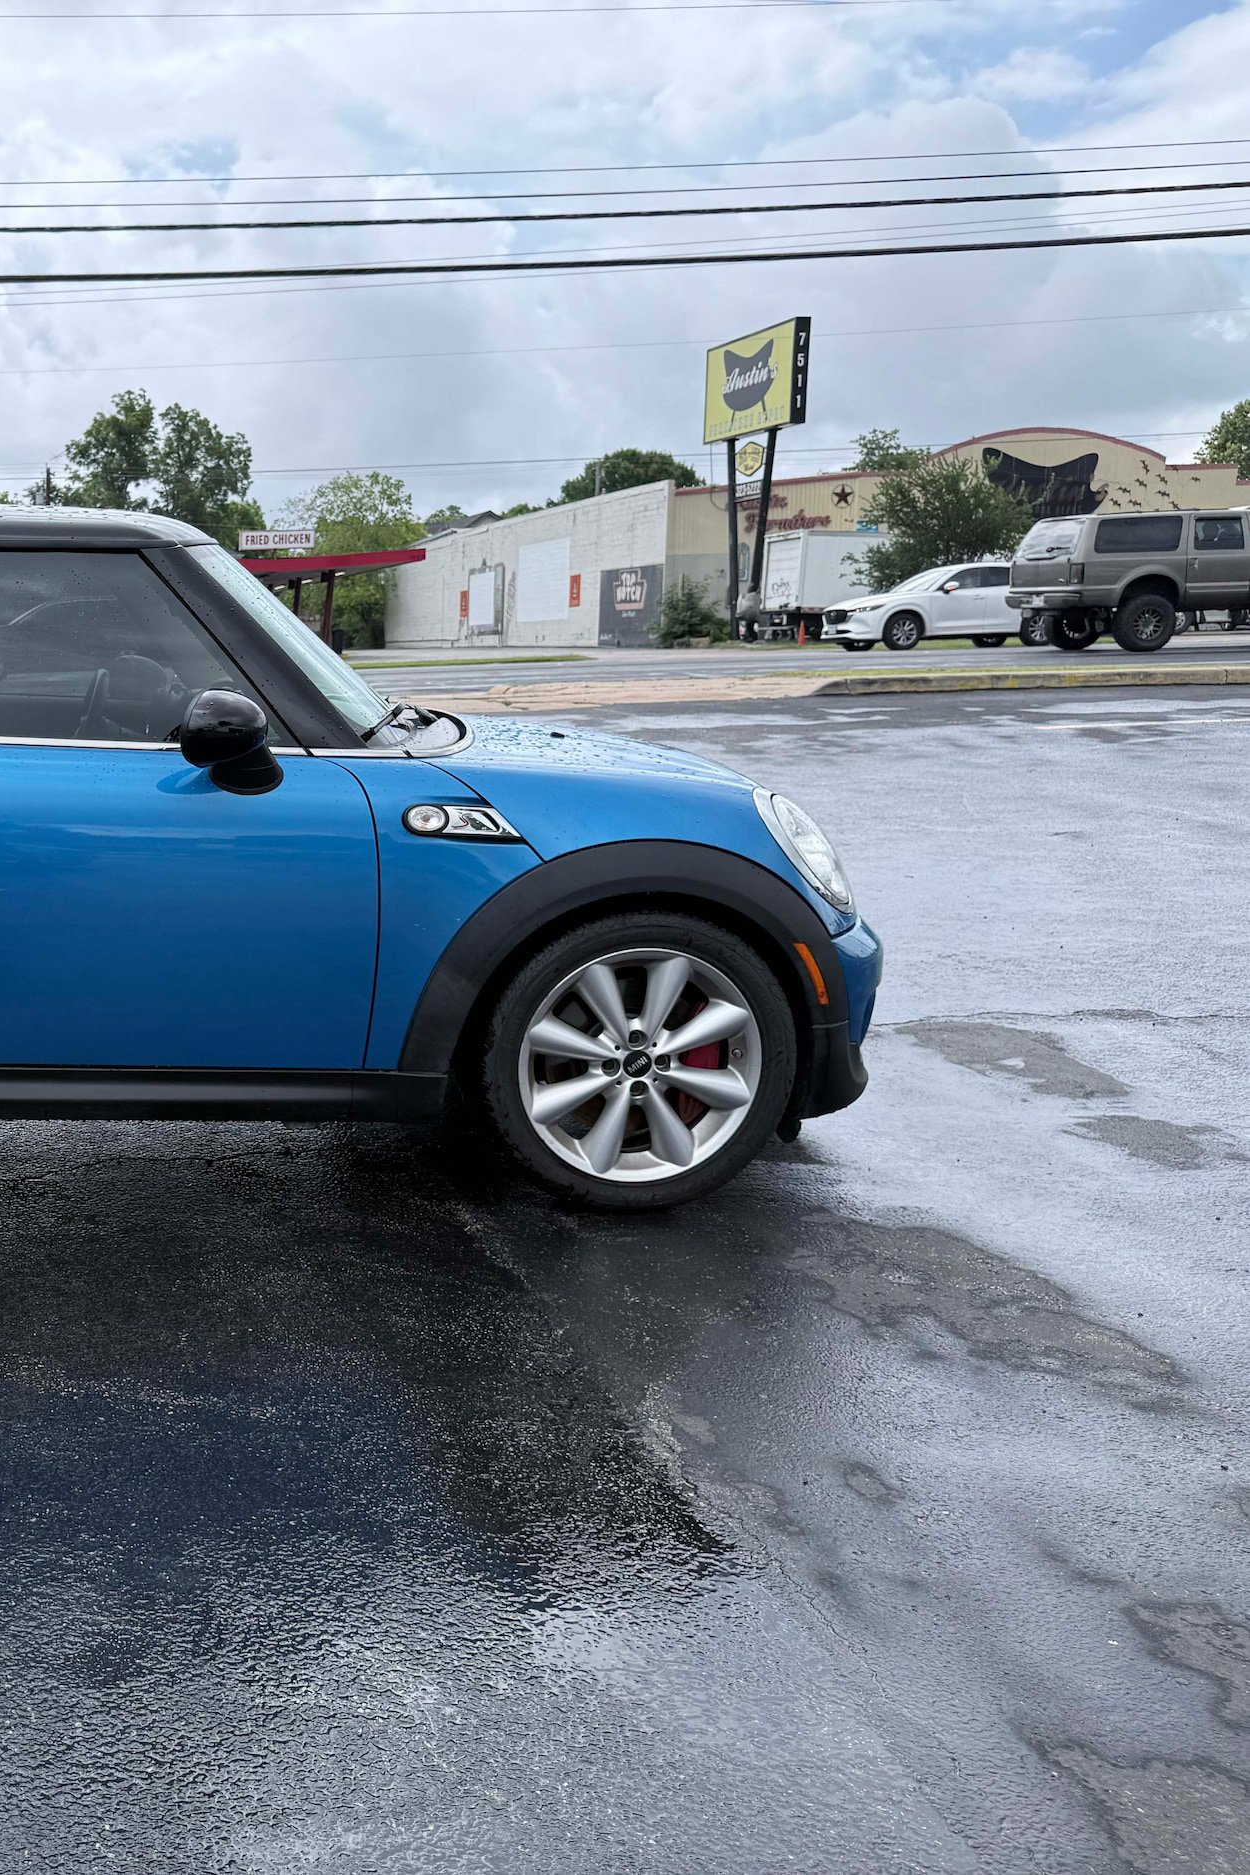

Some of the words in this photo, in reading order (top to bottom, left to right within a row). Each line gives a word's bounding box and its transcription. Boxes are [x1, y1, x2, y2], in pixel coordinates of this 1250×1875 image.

[721, 355, 778, 394] Austin's
[245, 534, 269, 546] FRIED
[272, 533, 310, 545] CHICKEN
[621, 572, 636, 586] TOP
[616, 585, 642, 602] NOTCH
[627, 1055, 648, 1073] MINI
